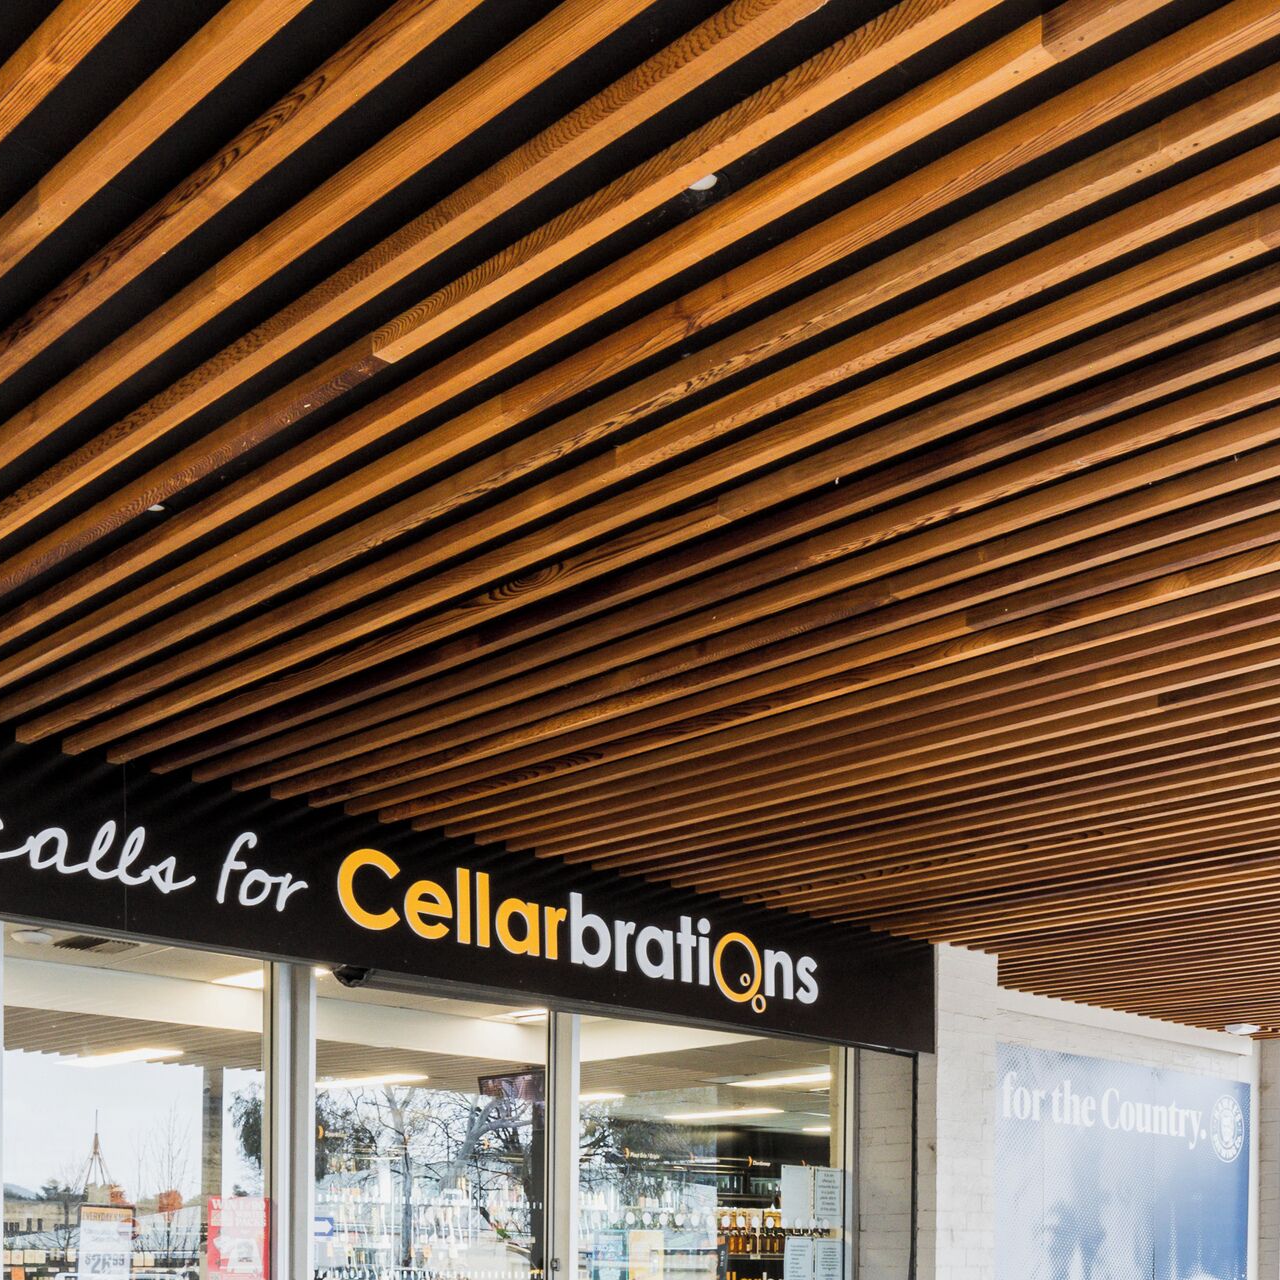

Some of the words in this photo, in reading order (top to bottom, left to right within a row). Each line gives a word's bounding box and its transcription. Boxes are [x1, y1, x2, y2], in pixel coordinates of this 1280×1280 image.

[217, 832, 308, 912] for
[337, 848, 818, 1011] Cellarbrations
[1002, 1071, 1047, 1120] for
[1052, 1080, 1096, 1126] the
[1101, 1087, 1207, 1150] Country.
